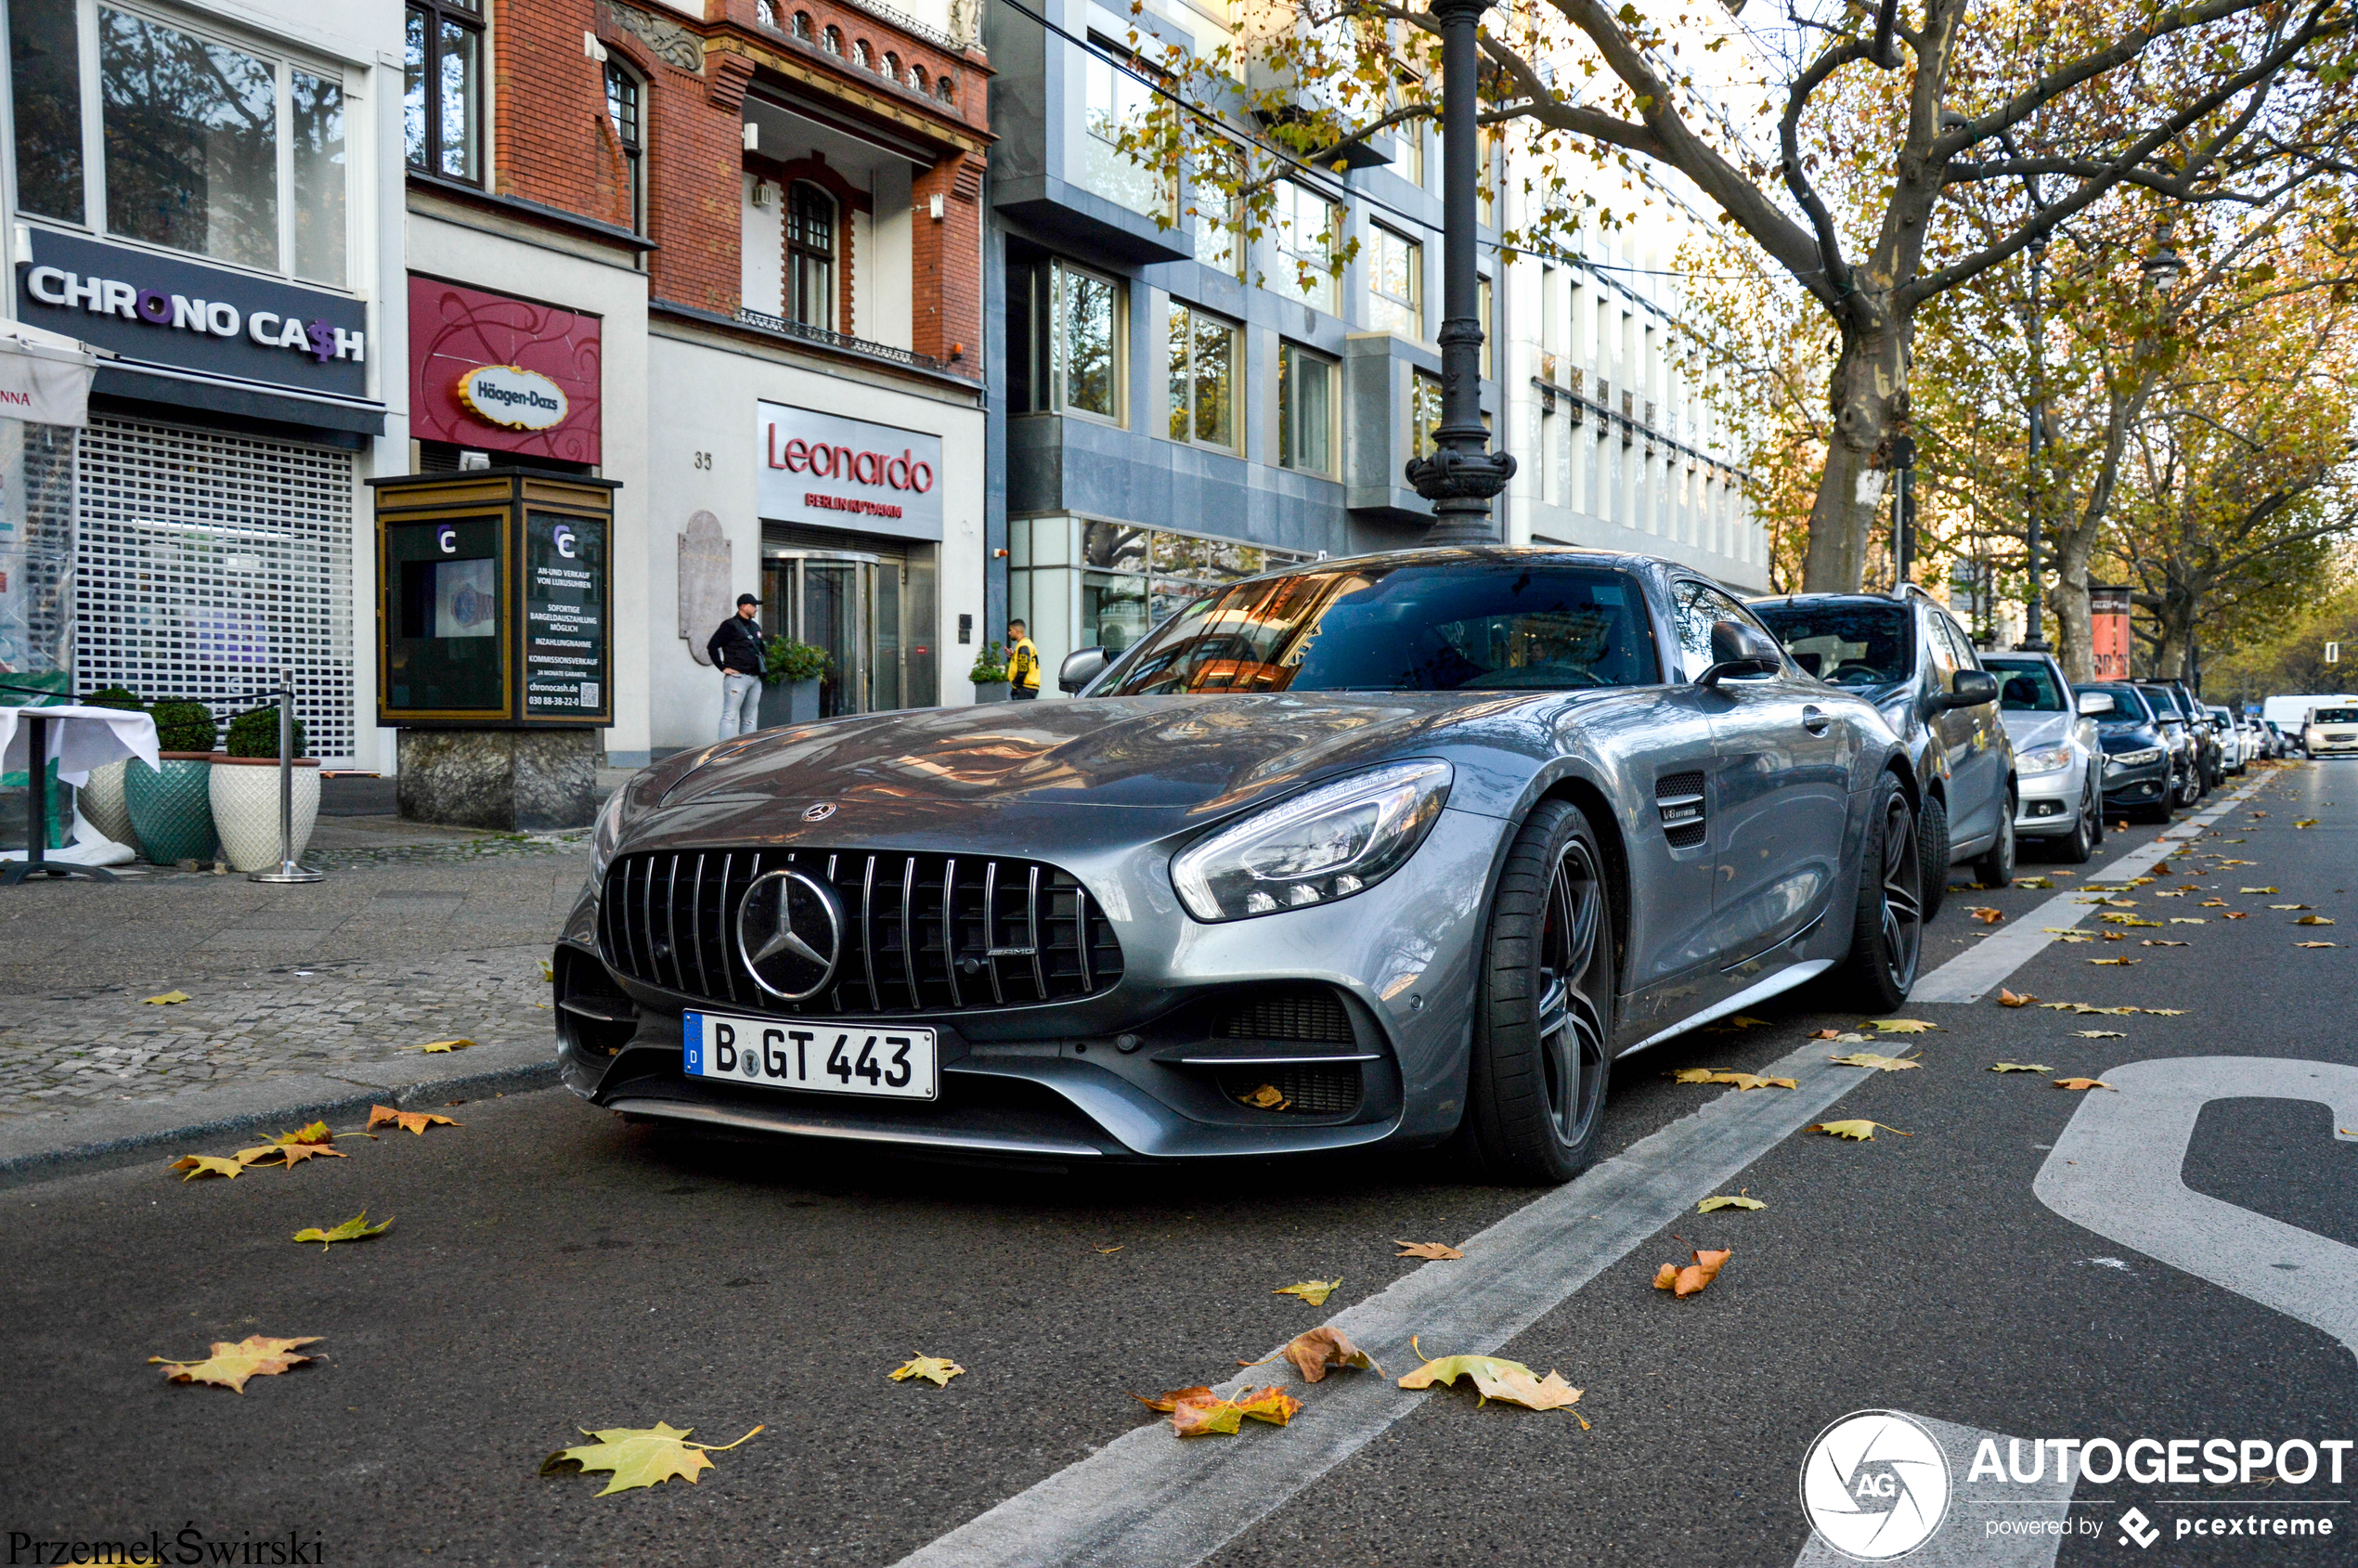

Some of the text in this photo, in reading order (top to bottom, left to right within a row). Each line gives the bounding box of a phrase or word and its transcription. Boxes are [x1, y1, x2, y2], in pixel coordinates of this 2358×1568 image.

[27, 266, 240, 337] CHRONO
[694, 451, 712, 471] 35
[769, 422, 933, 493] Leonardo
[805, 492, 902, 519] BERLIN KU'DAMM
[564, 570, 590, 579] VERKAUF
[537, 577, 591, 589] VON LUXUSUHREN
[548, 604, 580, 614] SOFORTIGE
[530, 612, 598, 625] BARGELDAUSZAHLUNG
[550, 623, 578, 633] MÖGLICH
[535, 638, 592, 648] INZAHLUNGNAHME
[528, 654, 599, 666] KOMMISSIONSVERKAUF
[529, 682, 578, 693] chronocash.de
[529, 696, 579, 706] 030 88-38-22-0
[690, 1050, 697, 1064] D
[716, 1022, 737, 1072] B
[763, 1029, 814, 1081] GT
[826, 1034, 912, 1088] 443
